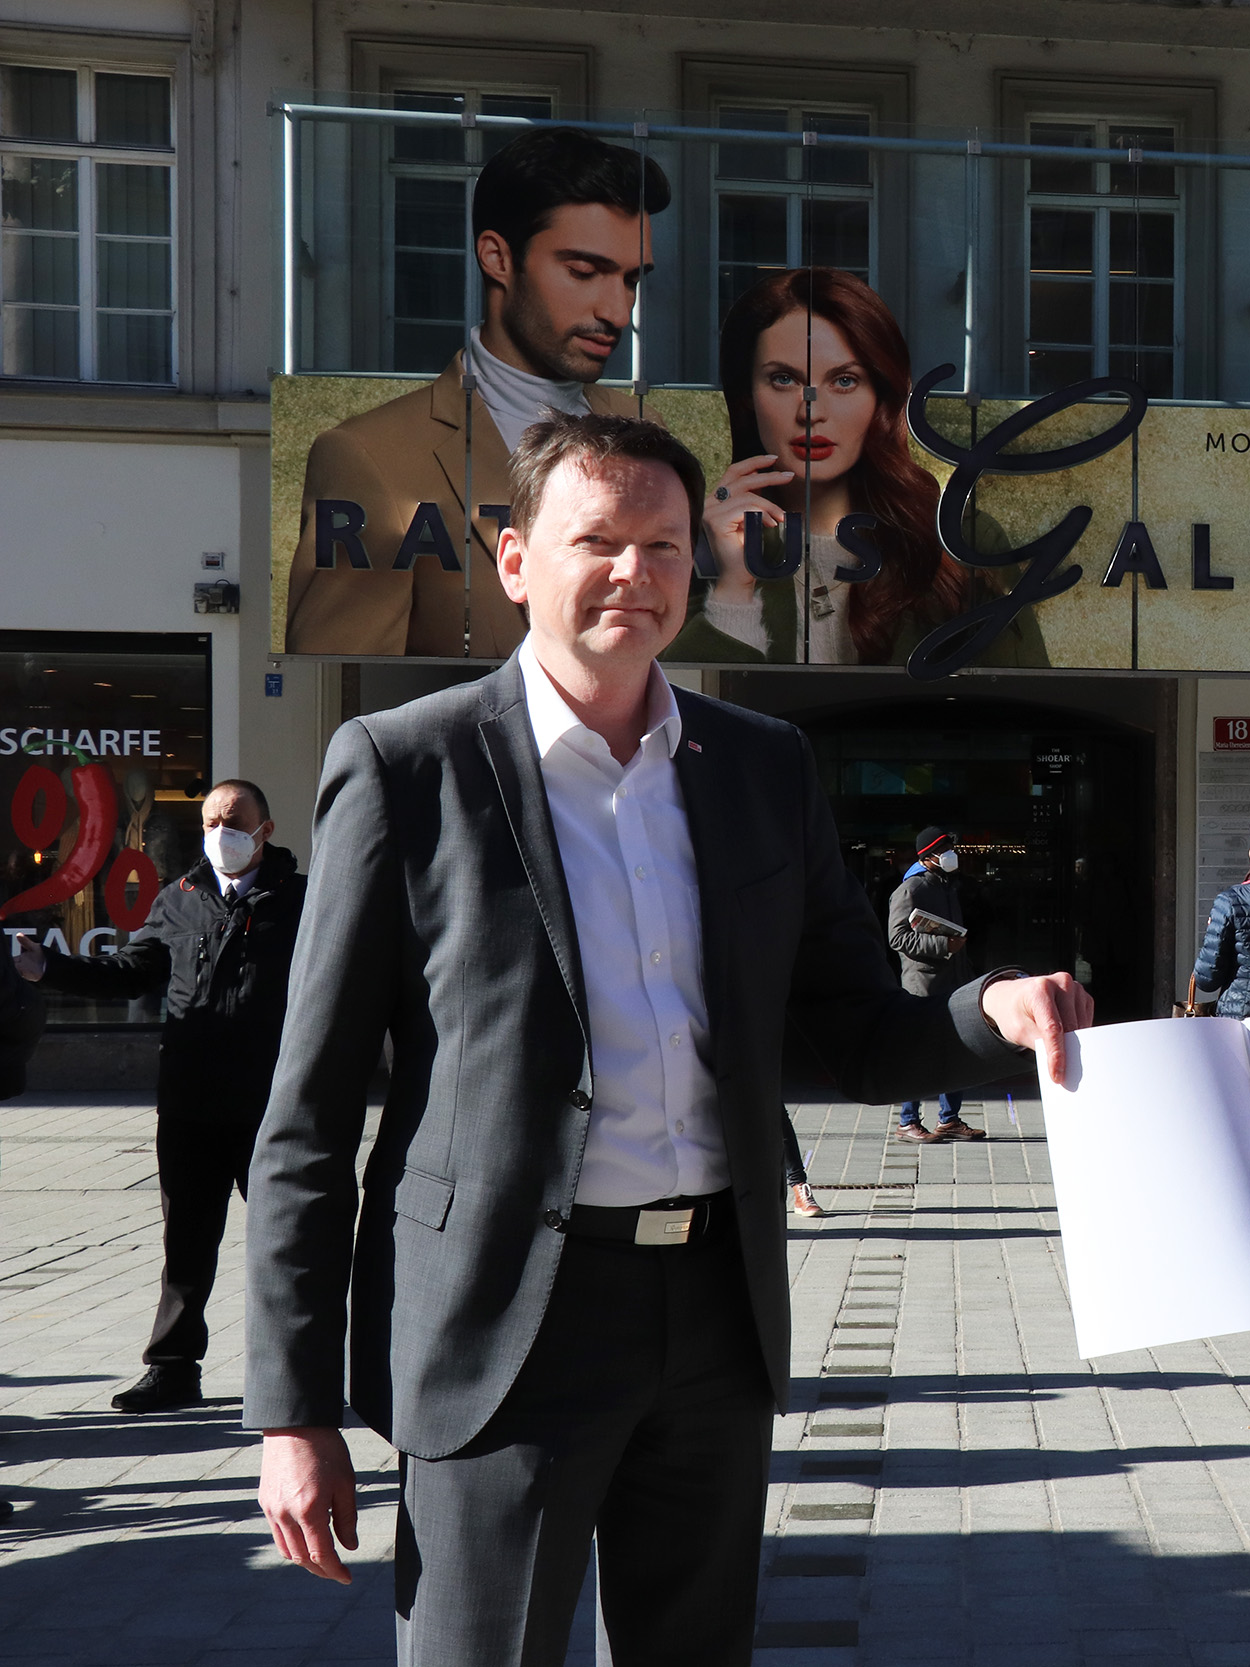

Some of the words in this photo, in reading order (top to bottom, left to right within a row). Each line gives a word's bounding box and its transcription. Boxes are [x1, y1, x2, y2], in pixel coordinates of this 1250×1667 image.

[314, 500, 883, 583] RAUS
[0, 728, 161, 756] SCHARFE
[1227, 720, 1248, 740] 18
[3, 927, 150, 957] TAG
